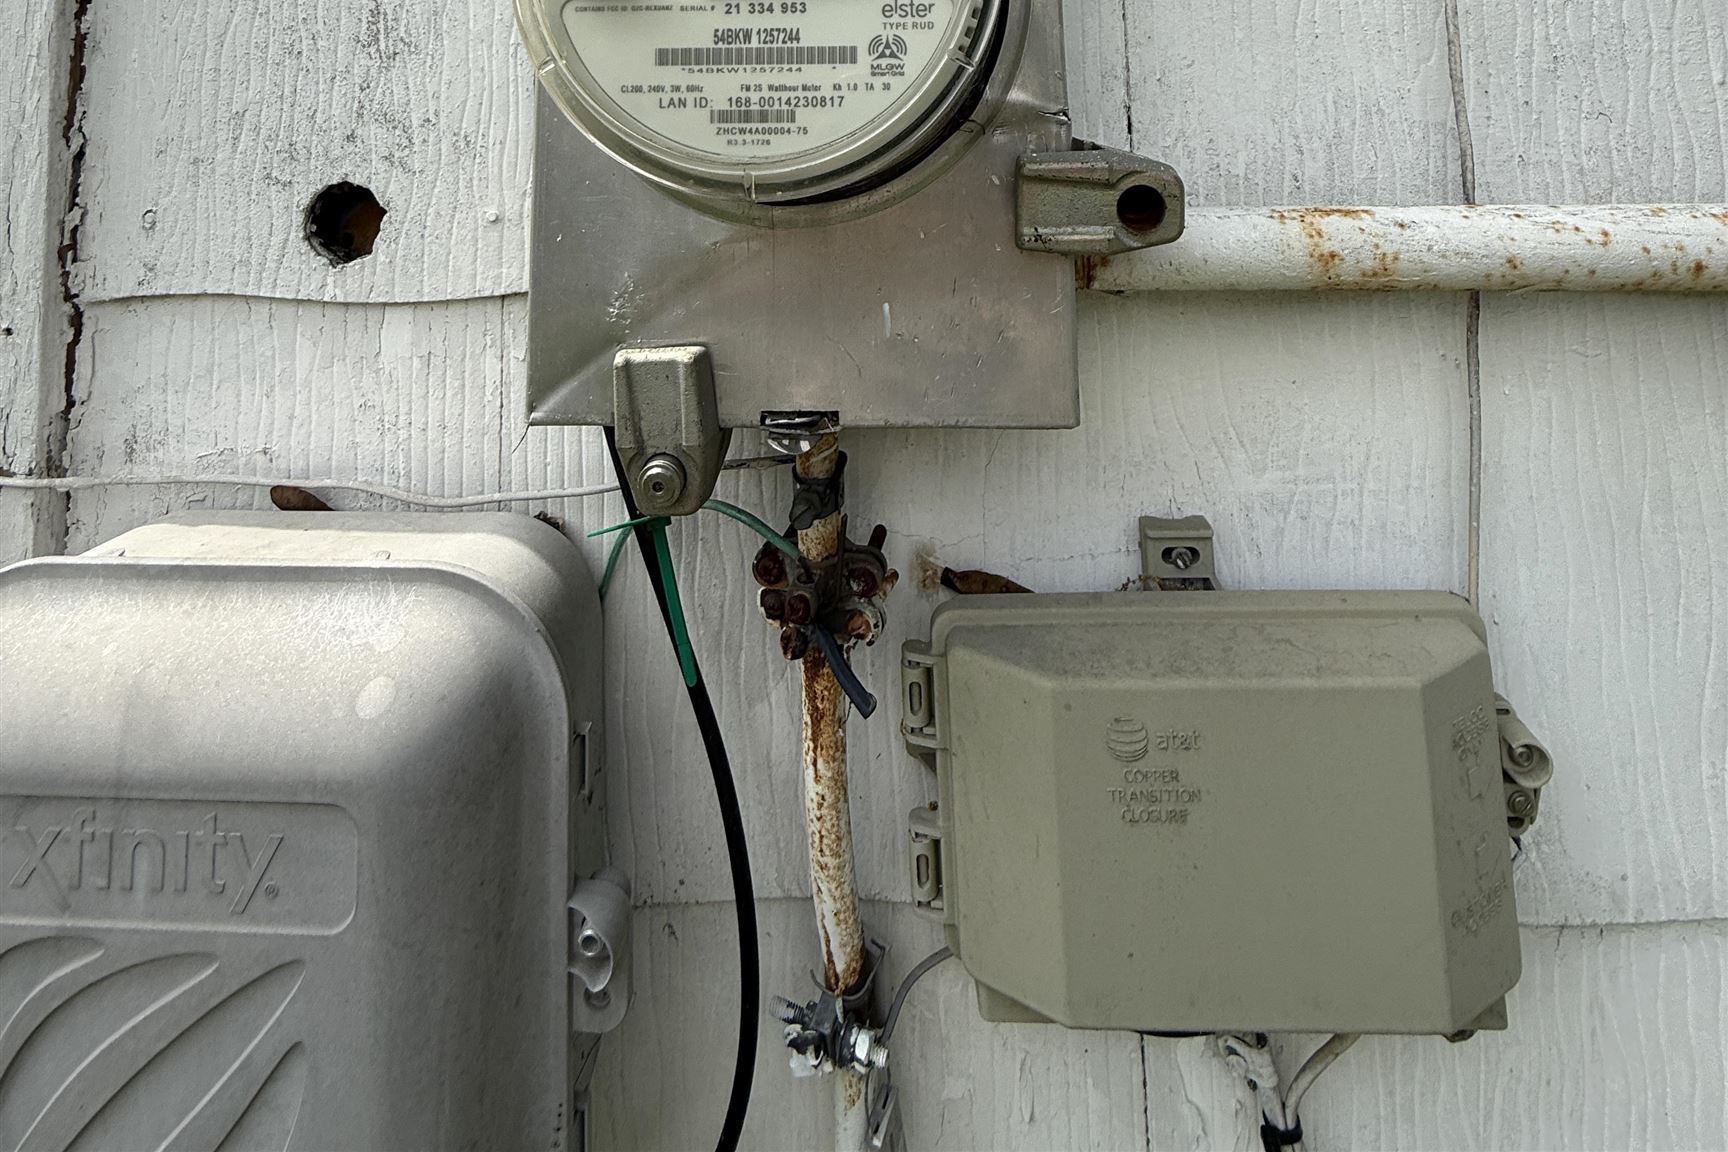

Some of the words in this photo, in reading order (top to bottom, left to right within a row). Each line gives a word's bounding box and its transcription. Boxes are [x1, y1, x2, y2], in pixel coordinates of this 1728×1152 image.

[724, 3, 741, 15] 21
[748, 2, 775, 14] 334
[780, 2, 807, 14] 953
[882, 22, 909, 30] TYPE
[912, 21, 935, 30] RUD
[713, 28, 753, 45] 54BKW
[756, 28, 801, 44] 1257244
[870, 63, 906, 71] MLGW
[740, 83, 751, 92] FM
[767, 83, 799, 92] Watthour
[801, 83, 822, 92] Meter
[833, 82, 842, 91] Kh
[864, 82, 875, 91] TA
[881, 82, 891, 91] 30
[659, 97, 687, 109] LAN
[694, 96, 713, 109] ID:
[727, 96, 845, 109] 168-0014230817
[715, 127, 808, 136] ZHCW4A00004-75
[1156, 728, 1201, 751] at&t
[1122, 767, 1180, 784] COPPER
[1107, 787, 1202, 804] TRANSITION
[1121, 806, 1190, 824] CLOSURE
